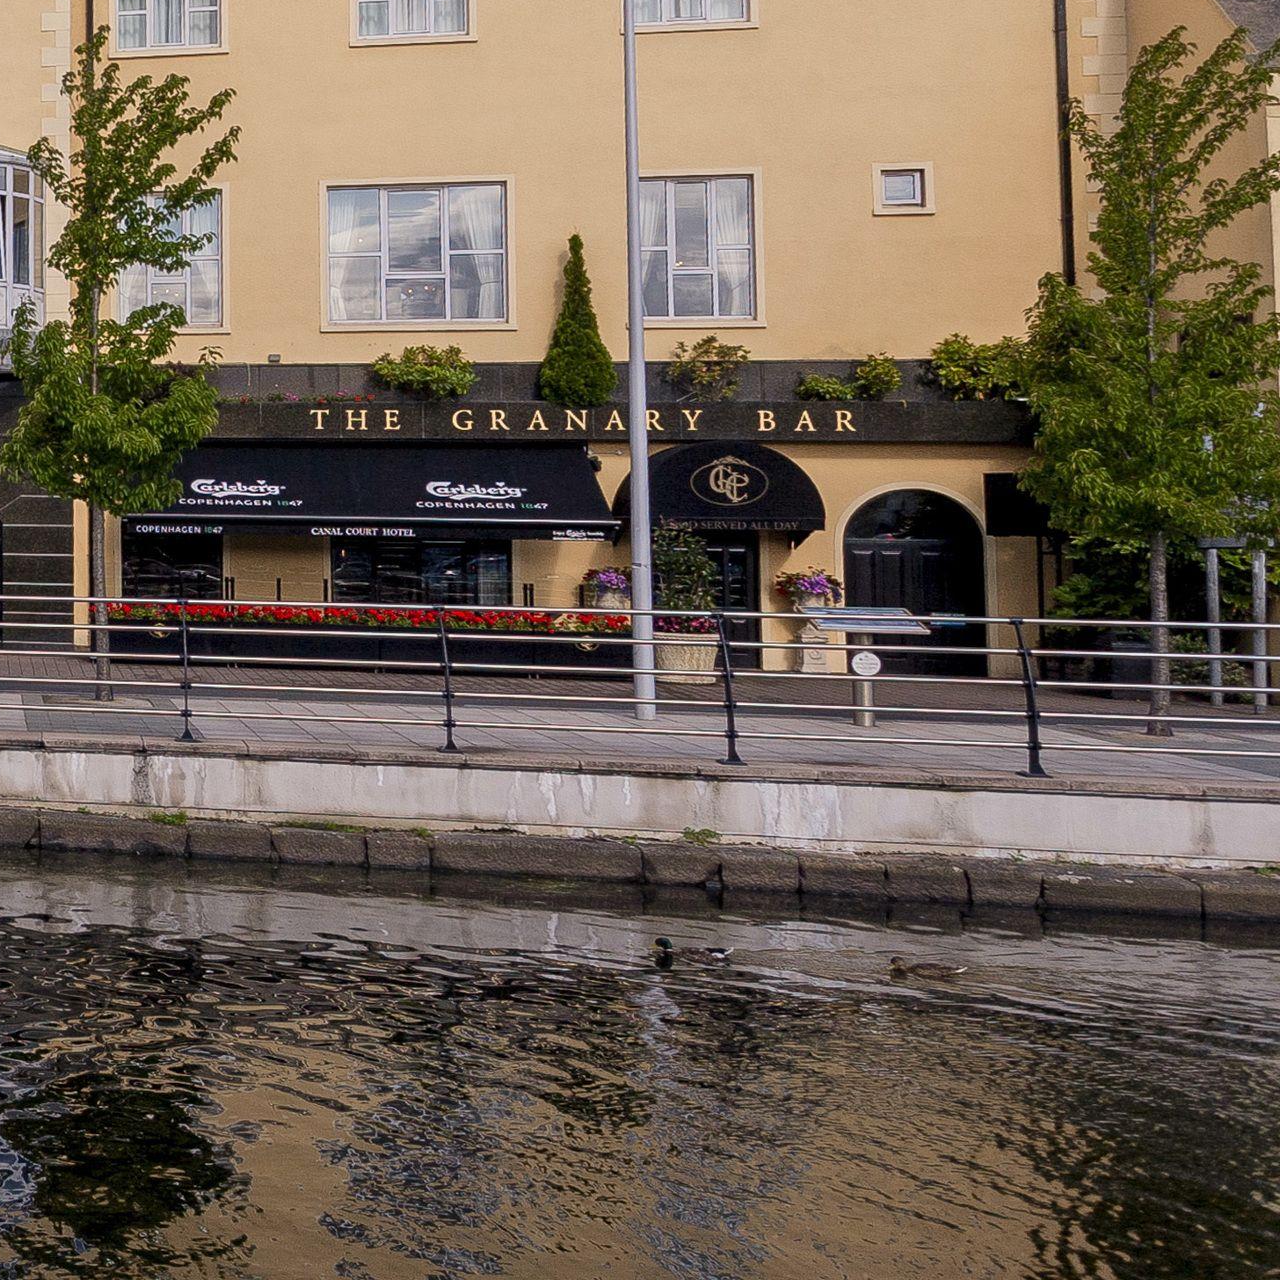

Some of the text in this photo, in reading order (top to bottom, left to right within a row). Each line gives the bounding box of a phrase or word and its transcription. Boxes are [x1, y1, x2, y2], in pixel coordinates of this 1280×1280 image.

[309, 409, 857, 432] THE GRANARY BAR
[190, 478, 281, 498] Carlsberg
[425, 481, 523, 501] Carlsberg
[178, 498, 272, 507] COPENHAGEN
[415, 501, 515, 509] COPENHAGEN
[136, 525, 202, 534] COPENHAGEN
[700, 520, 747, 530] SERVED
[750, 520, 771, 530] ALL
[774, 521, 801, 531] DAY
[310, 527, 416, 537] CANAL COURT HOTEL
